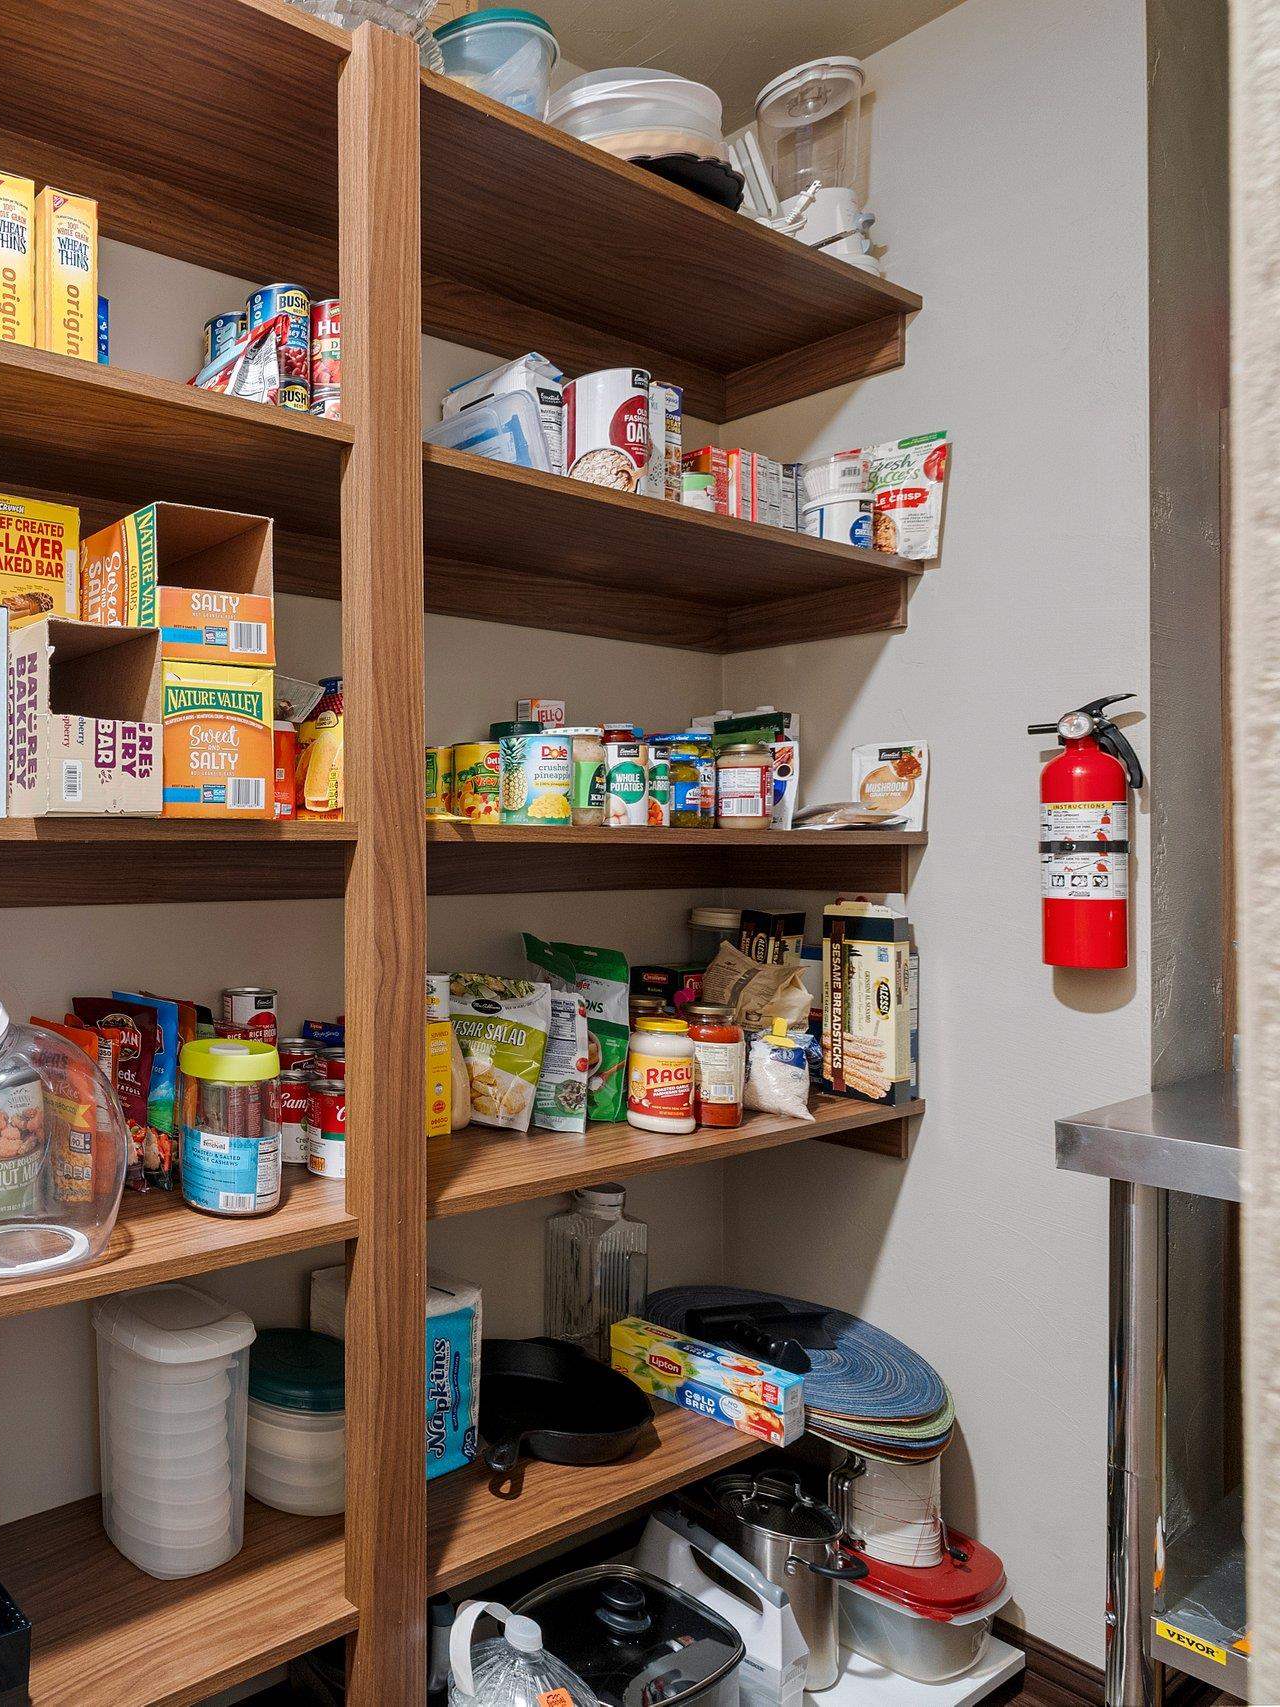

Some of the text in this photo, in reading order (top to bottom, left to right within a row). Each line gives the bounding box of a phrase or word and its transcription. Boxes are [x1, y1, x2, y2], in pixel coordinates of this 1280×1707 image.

[57, 236, 89, 256] WHEAT
[889, 492, 922, 504] CRISP
[15, 520, 65, 539] CREATED
[137, 511, 155, 586] NATURE
[35, 560, 64, 579] BAR
[130, 581, 138, 611] BARS
[191, 592, 240, 614] SALTY
[167, 689, 259, 716] NATURE VALLEY
[16, 655, 27, 790] BAKERY
[97, 720, 114, 768] BAR
[188, 724, 240, 747] Sweet
[189, 752, 239, 770] SALTY
[541, 745, 568, 760] Dole
[538, 764, 570, 773] crushed
[615, 773, 641, 783] WHOLE
[610, 782, 644, 792] POTATOES
[865, 783, 909, 794] MUSHROOM
[831, 943, 842, 1069] SESAME BREADSTICKS
[485, 1023, 527, 1047] SALAD
[651, 1356, 680, 1374] Lipton
[426, 1338, 450, 1459] Napkins
[684, 1389, 716, 1406] COLD
[685, 1399, 716, 1415] BREW
[1166, 1628, 1217, 1658] VEVOR
